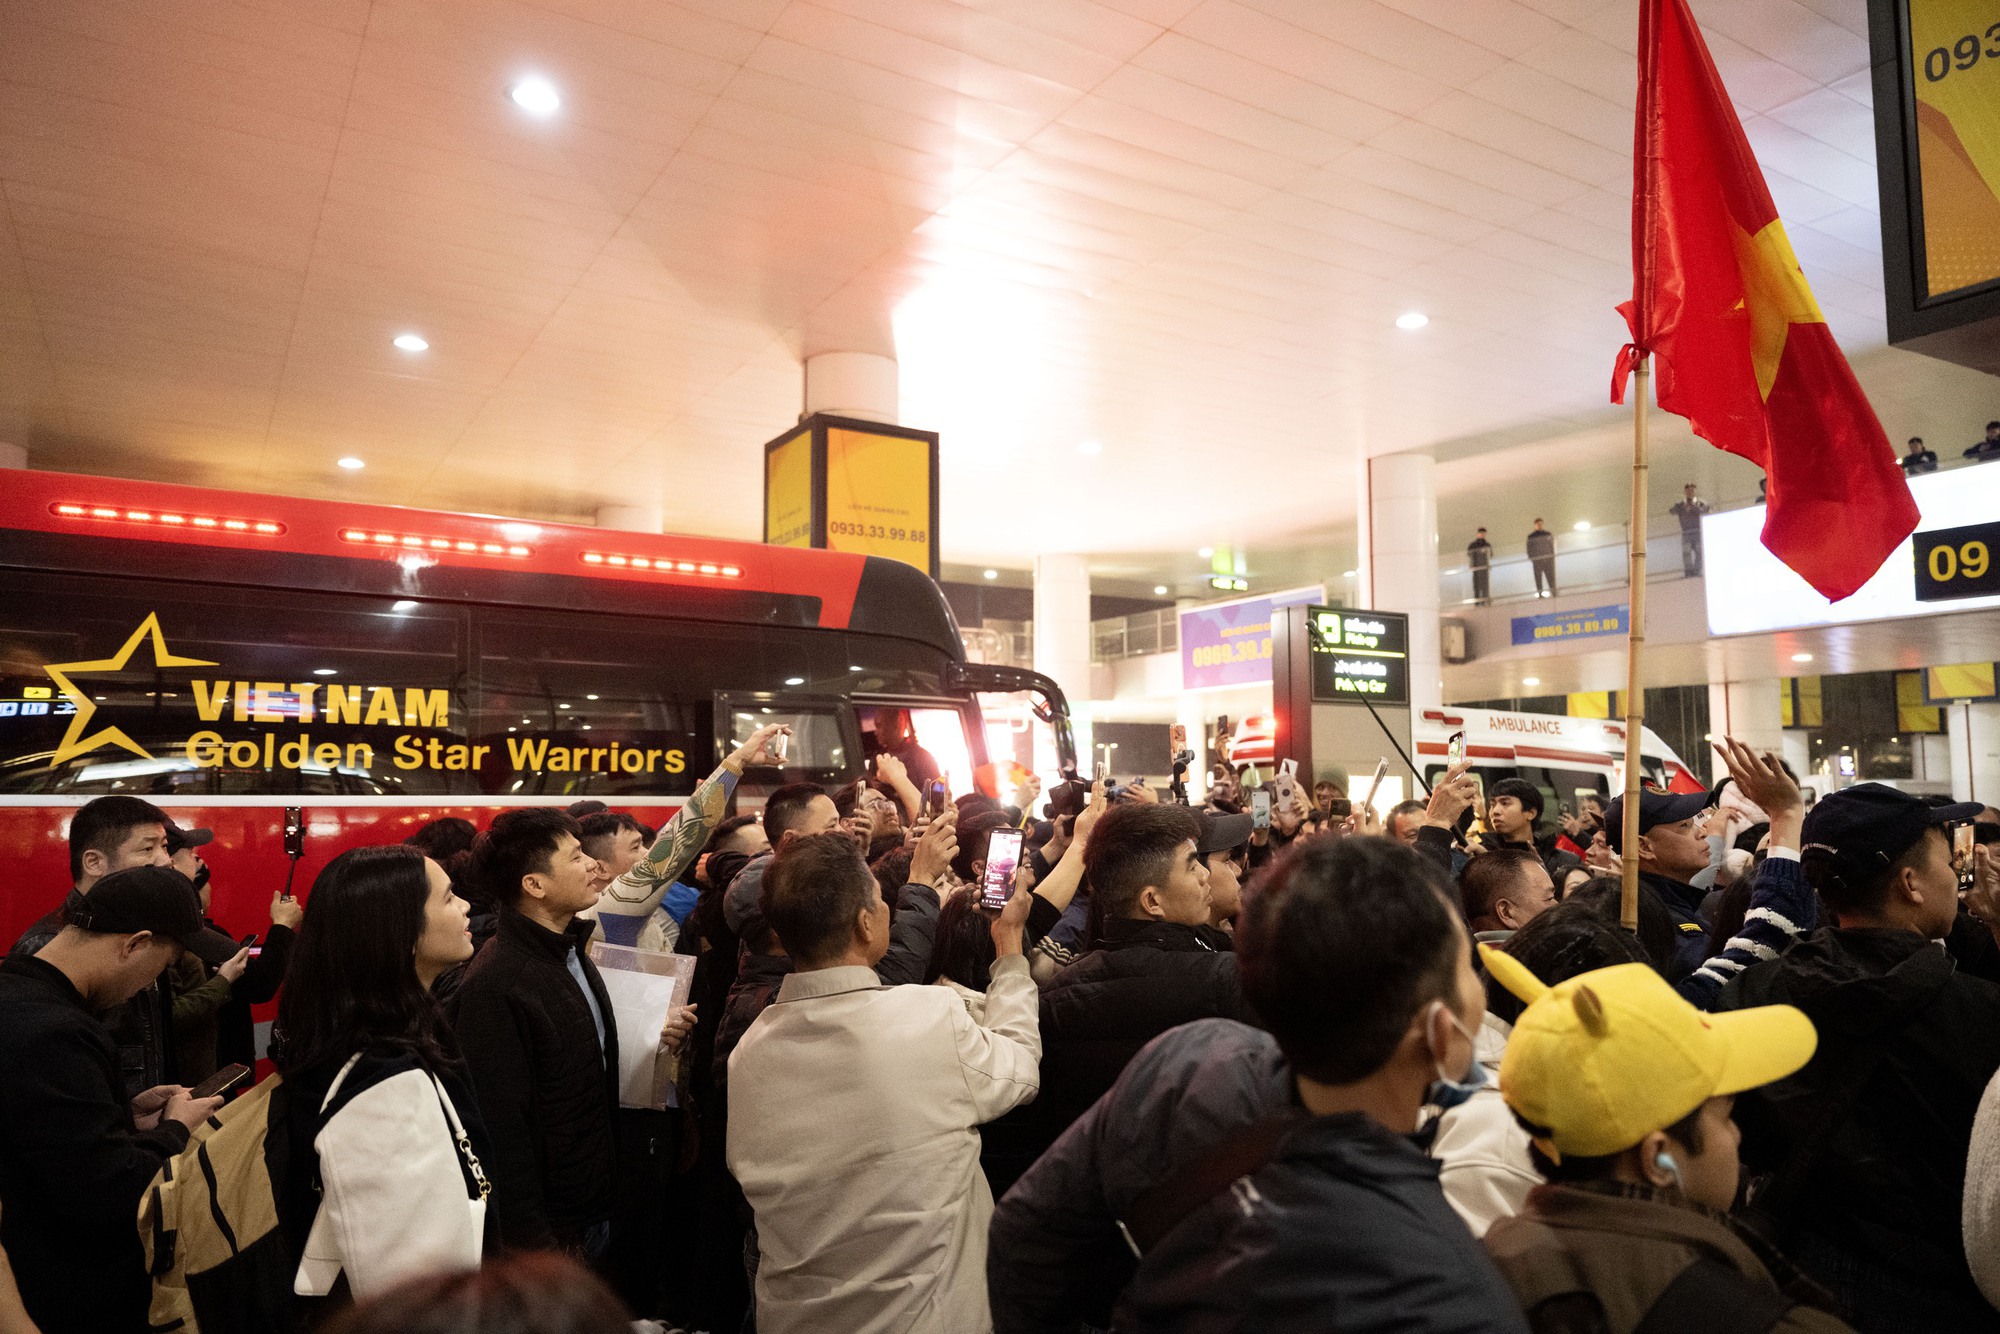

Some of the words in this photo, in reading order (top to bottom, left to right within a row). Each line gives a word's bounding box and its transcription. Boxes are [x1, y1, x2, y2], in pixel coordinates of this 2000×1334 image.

[830, 521, 926, 543] 0933.33.99.88
[1928, 541, 1989, 582] 09
[1369, 679, 1387, 693] Car
[191, 679, 449, 727] VIETNAM
[1489, 716, 1562, 735] AMBULANCE
[186, 730, 372, 770] Golden
[393, 734, 490, 770] Star
[506, 738, 685, 773] Warriors
